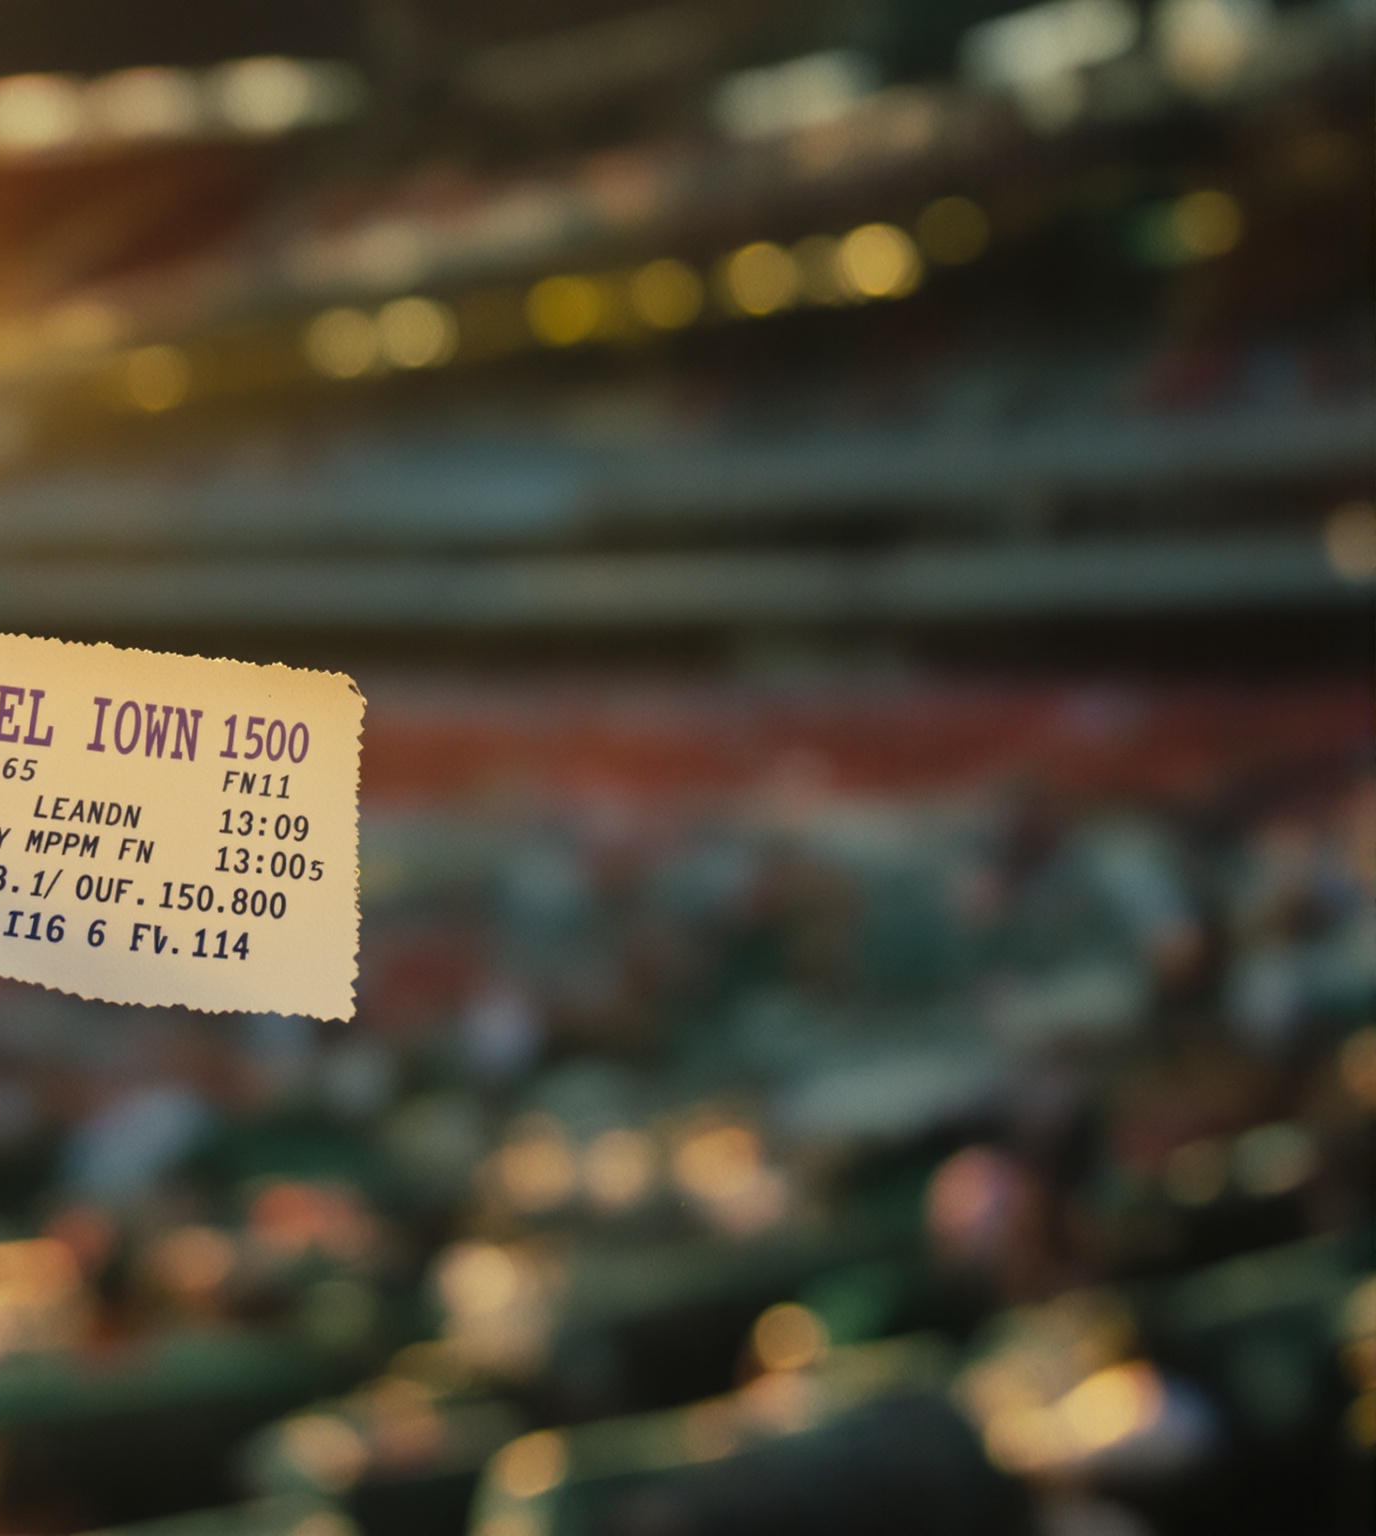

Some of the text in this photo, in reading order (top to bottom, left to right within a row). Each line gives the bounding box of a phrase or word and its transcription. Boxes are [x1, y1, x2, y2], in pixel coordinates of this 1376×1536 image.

[85, 696, 204, 762] IOWN
[219, 713, 310, 764] 1500
[221, 769, 290, 800] FN11
[32, 794, 143, 830] LEANDN
[218, 808, 310, 843] 13:09
[24, 828, 101, 859] MPPM
[117, 837, 155, 865] FN
[86, 918, 108, 948] 6
